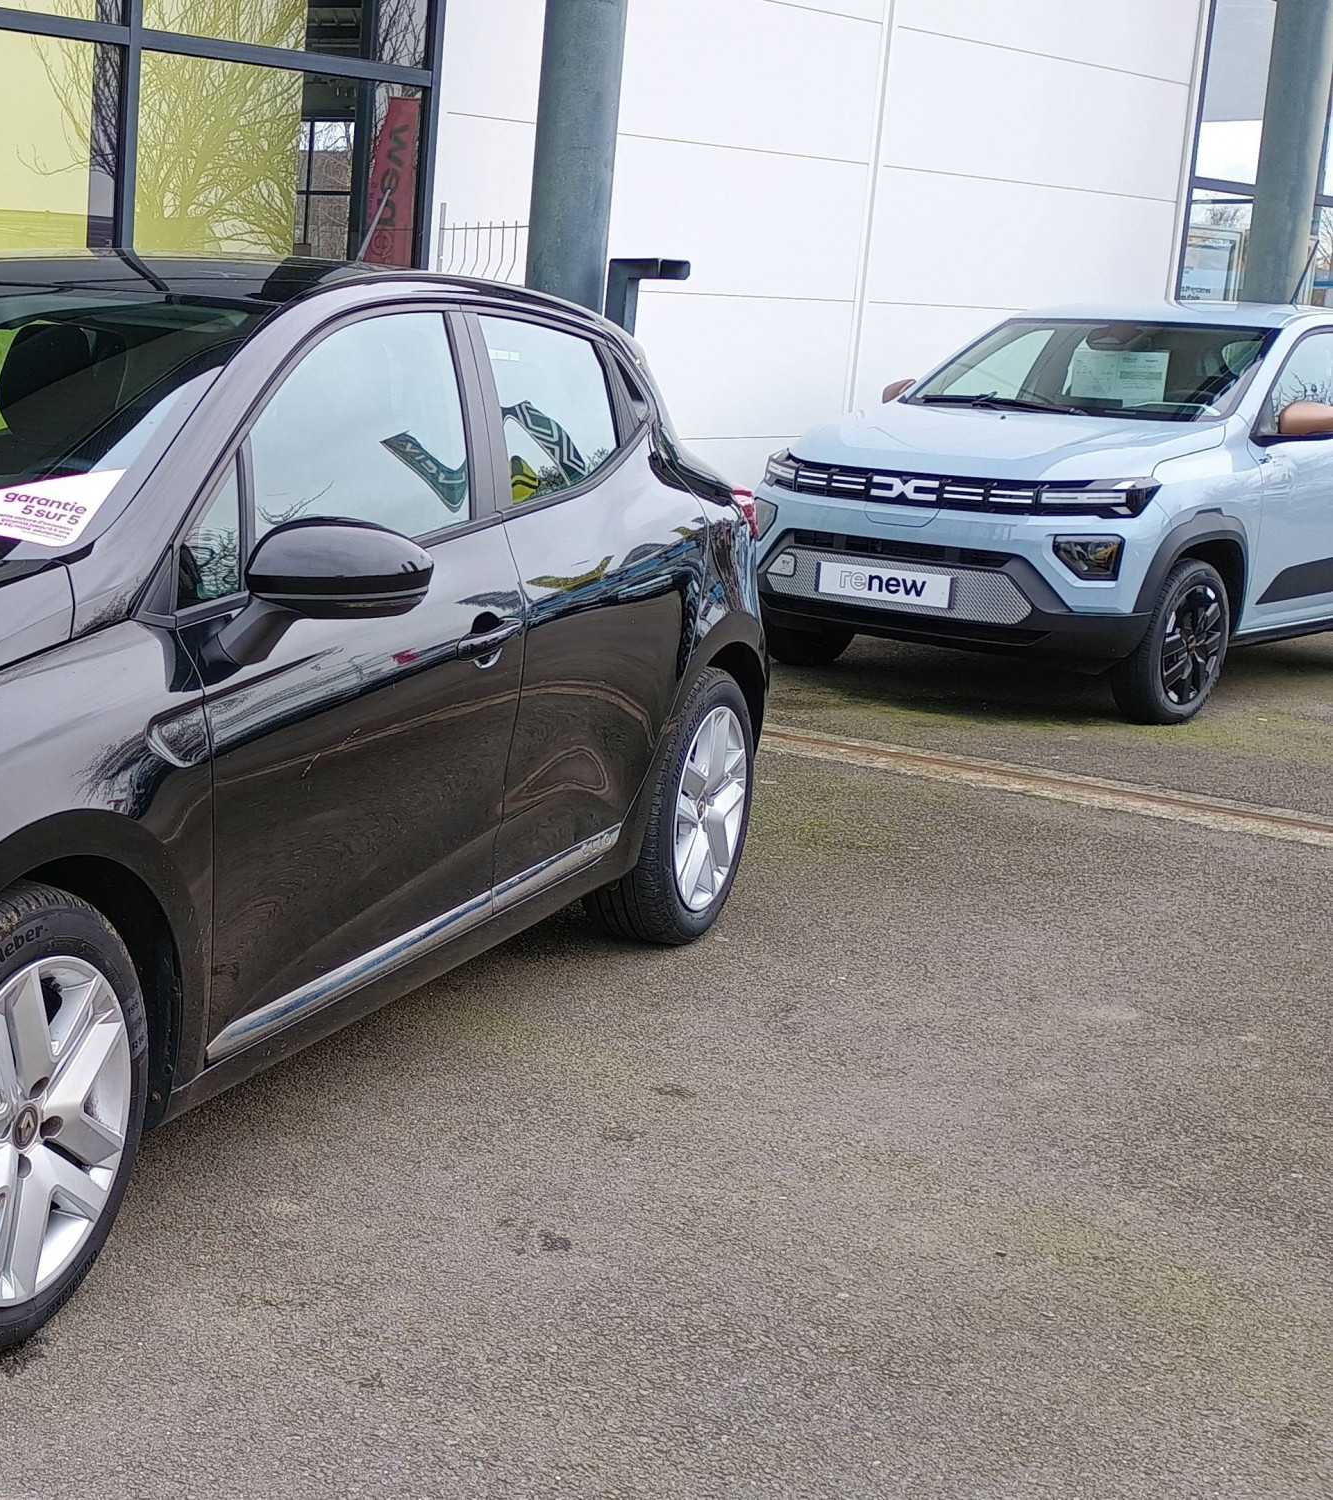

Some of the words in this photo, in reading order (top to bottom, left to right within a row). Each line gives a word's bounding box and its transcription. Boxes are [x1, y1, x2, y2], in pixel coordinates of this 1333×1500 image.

[3, 492, 87, 515] garantie
[21, 505, 35, 515] 5
[34, 509, 67, 522] sur
[67, 514, 81, 525] 5
[839, 570, 927, 598] renew
[582, 833, 612, 857] CLIO
